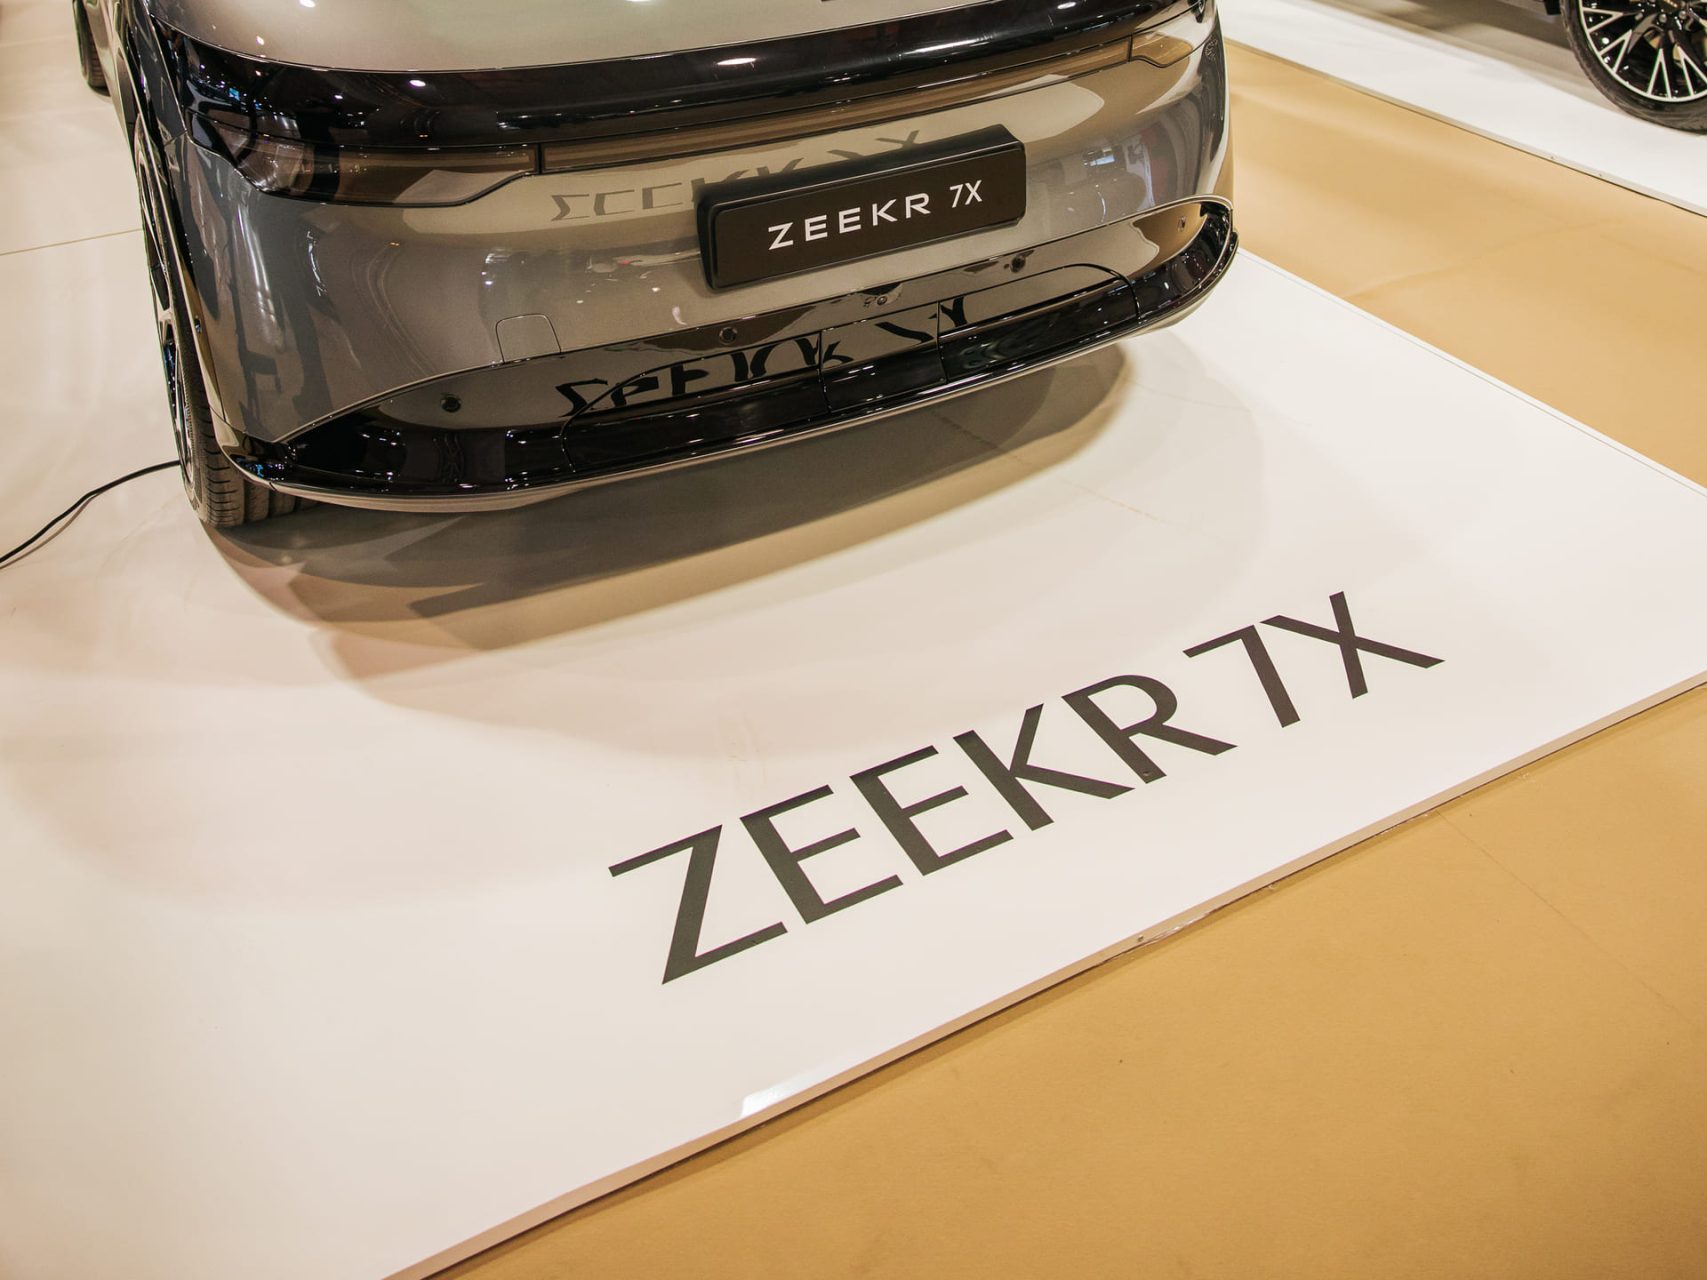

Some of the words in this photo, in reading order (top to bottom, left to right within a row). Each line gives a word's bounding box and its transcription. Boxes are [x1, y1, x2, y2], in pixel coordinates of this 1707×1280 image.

[768, 192, 932, 251] ZEEKR
[949, 179, 983, 209] 7X
[608, 673, 1238, 984] ZEEKR
[1182, 590, 1445, 728] 7X
